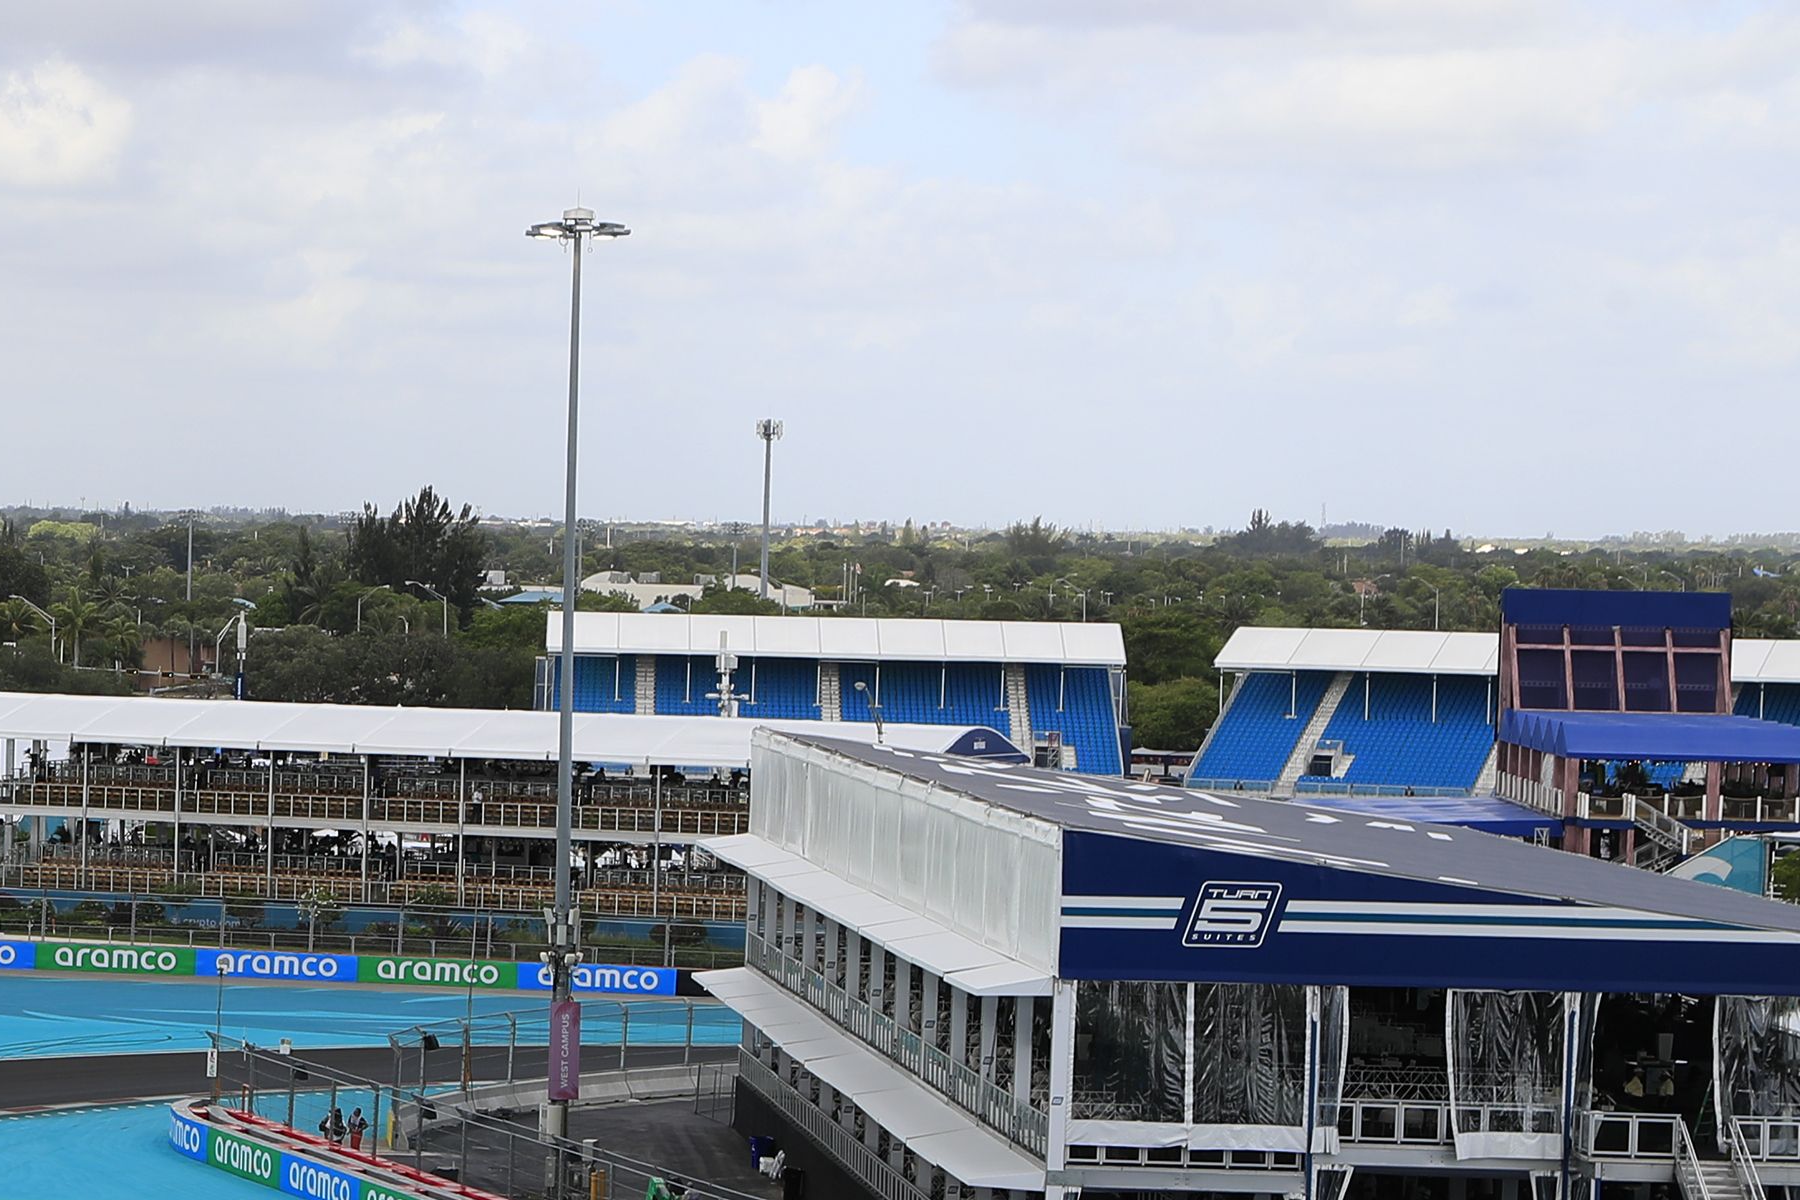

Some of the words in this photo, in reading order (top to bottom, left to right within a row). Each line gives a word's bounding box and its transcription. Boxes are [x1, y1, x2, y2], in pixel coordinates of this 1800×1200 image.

[1208, 889, 1272, 899] TURN
[1194, 899, 1269, 932] 5
[1192, 933, 1256, 941] SUITES
[54, 946, 176, 971] aramco
[216, 953, 338, 978] aramco
[377, 958, 499, 985] aramco
[537, 964, 659, 992] aamco
[561, 1014, 570, 1057] CAMPUS
[560, 1060, 569, 1088] WEST
[215, 1135, 271, 1179] aramco
